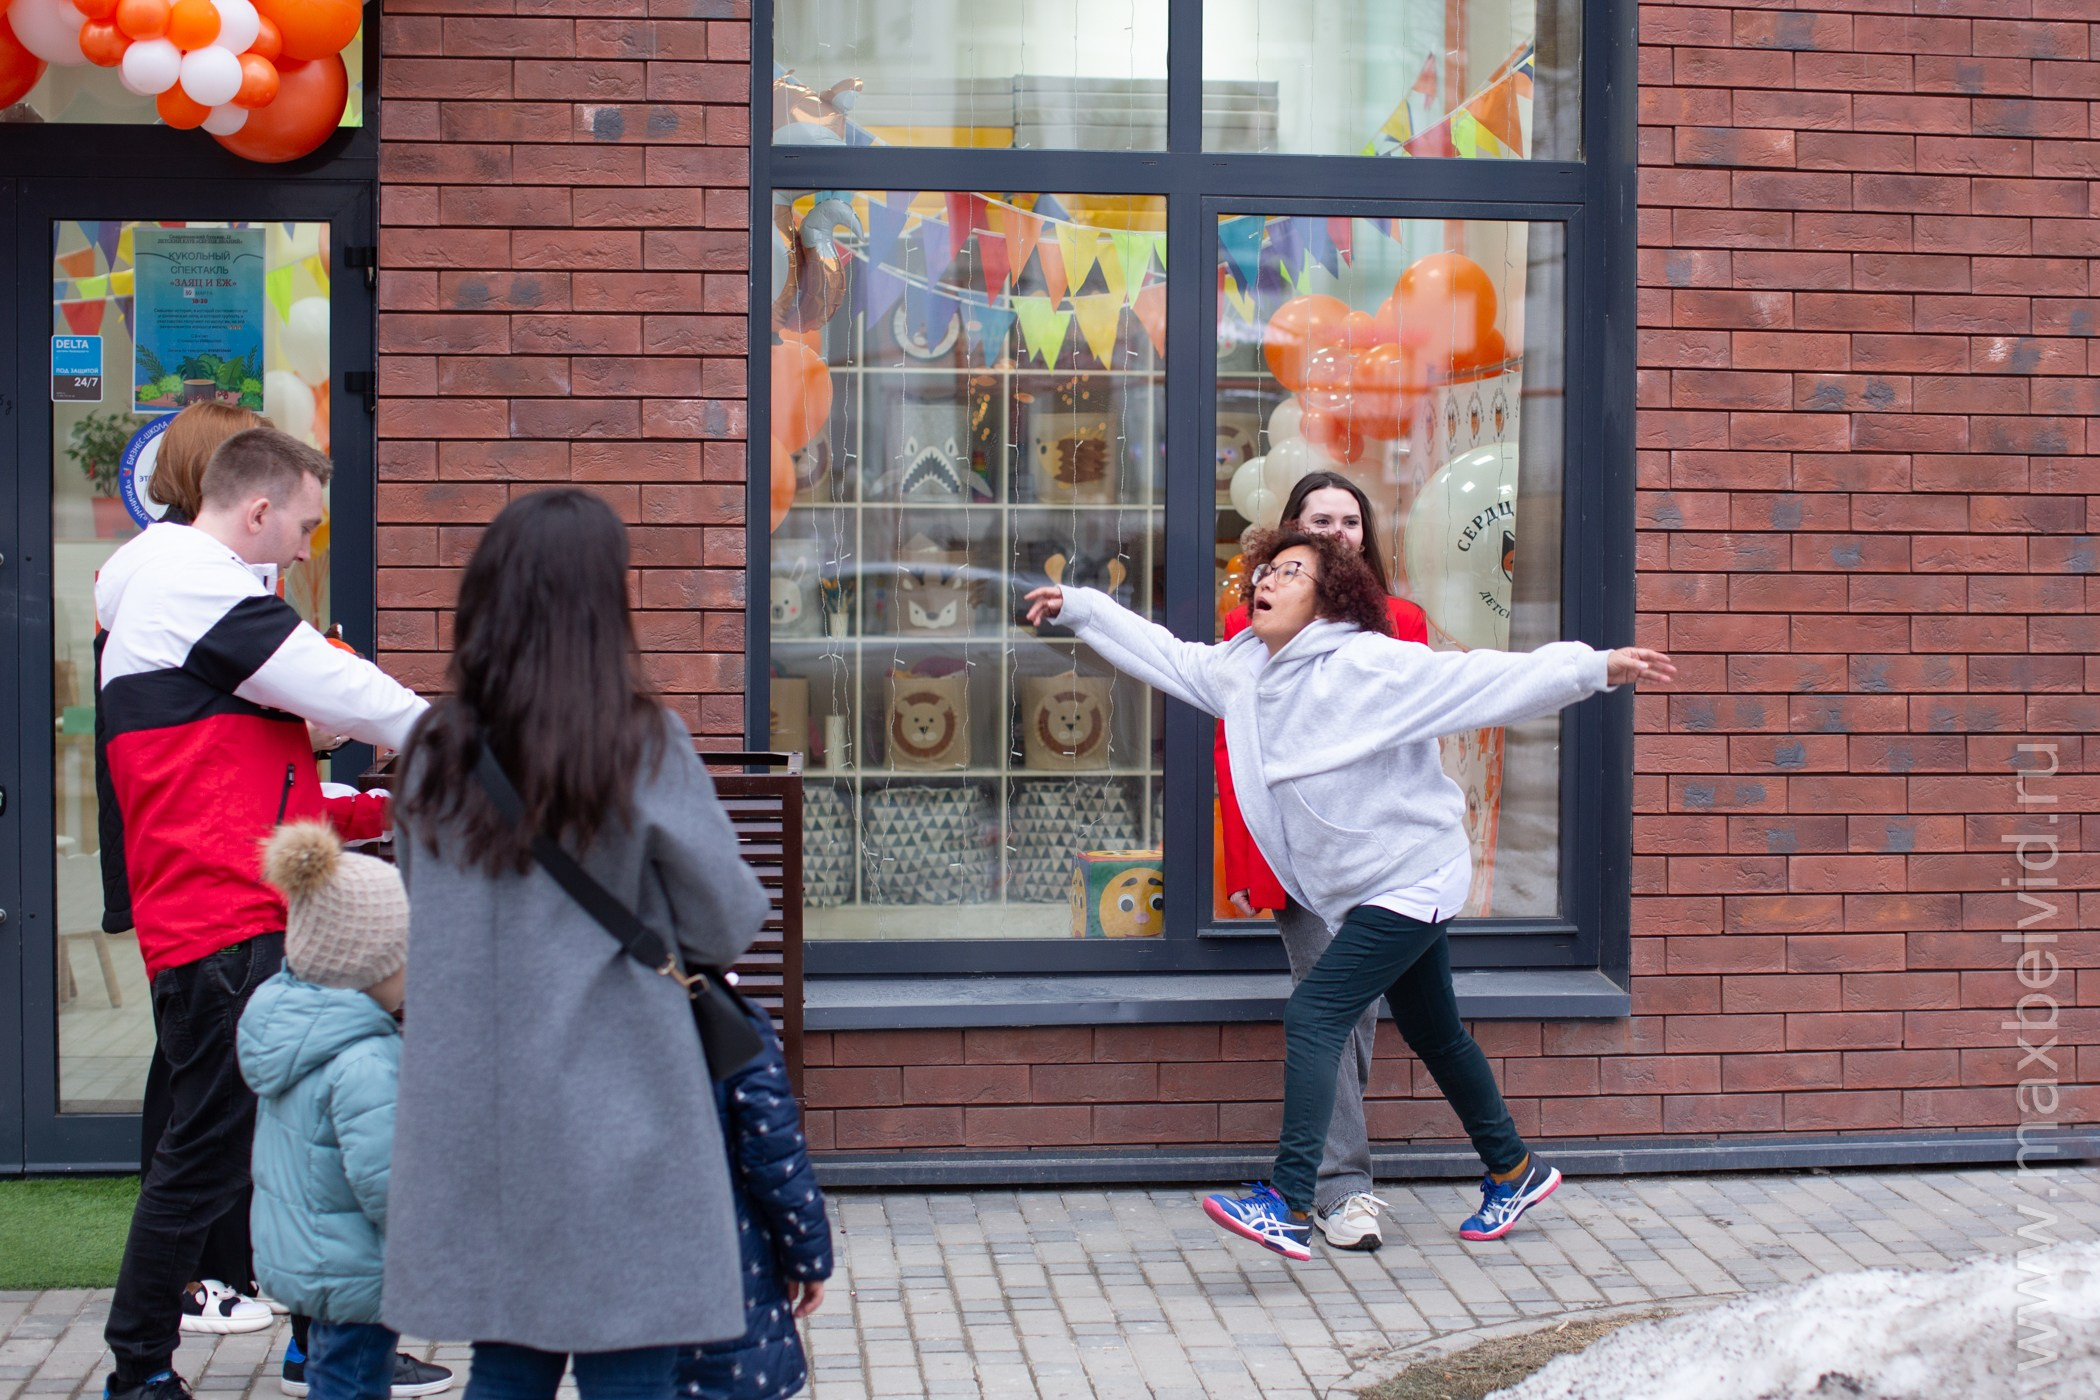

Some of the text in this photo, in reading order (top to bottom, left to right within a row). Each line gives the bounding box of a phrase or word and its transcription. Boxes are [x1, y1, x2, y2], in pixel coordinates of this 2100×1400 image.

[168, 251, 231, 261] КУКОЛЬНЫЙ
[170, 266, 229, 275] СПЕКТАКЛЬ
[170, 278, 203, 288] «ЗАЯЦ
[206, 278, 213, 287] И
[55, 339, 89, 349] DELTA
[74, 377, 98, 388] 24/7
[126, 421, 168, 465] БИЗНЕС-ШКОЛА
[125, 479, 148, 521] «УМНИЧКА»
[1457, 501, 1514, 552] СЕРДЦ
